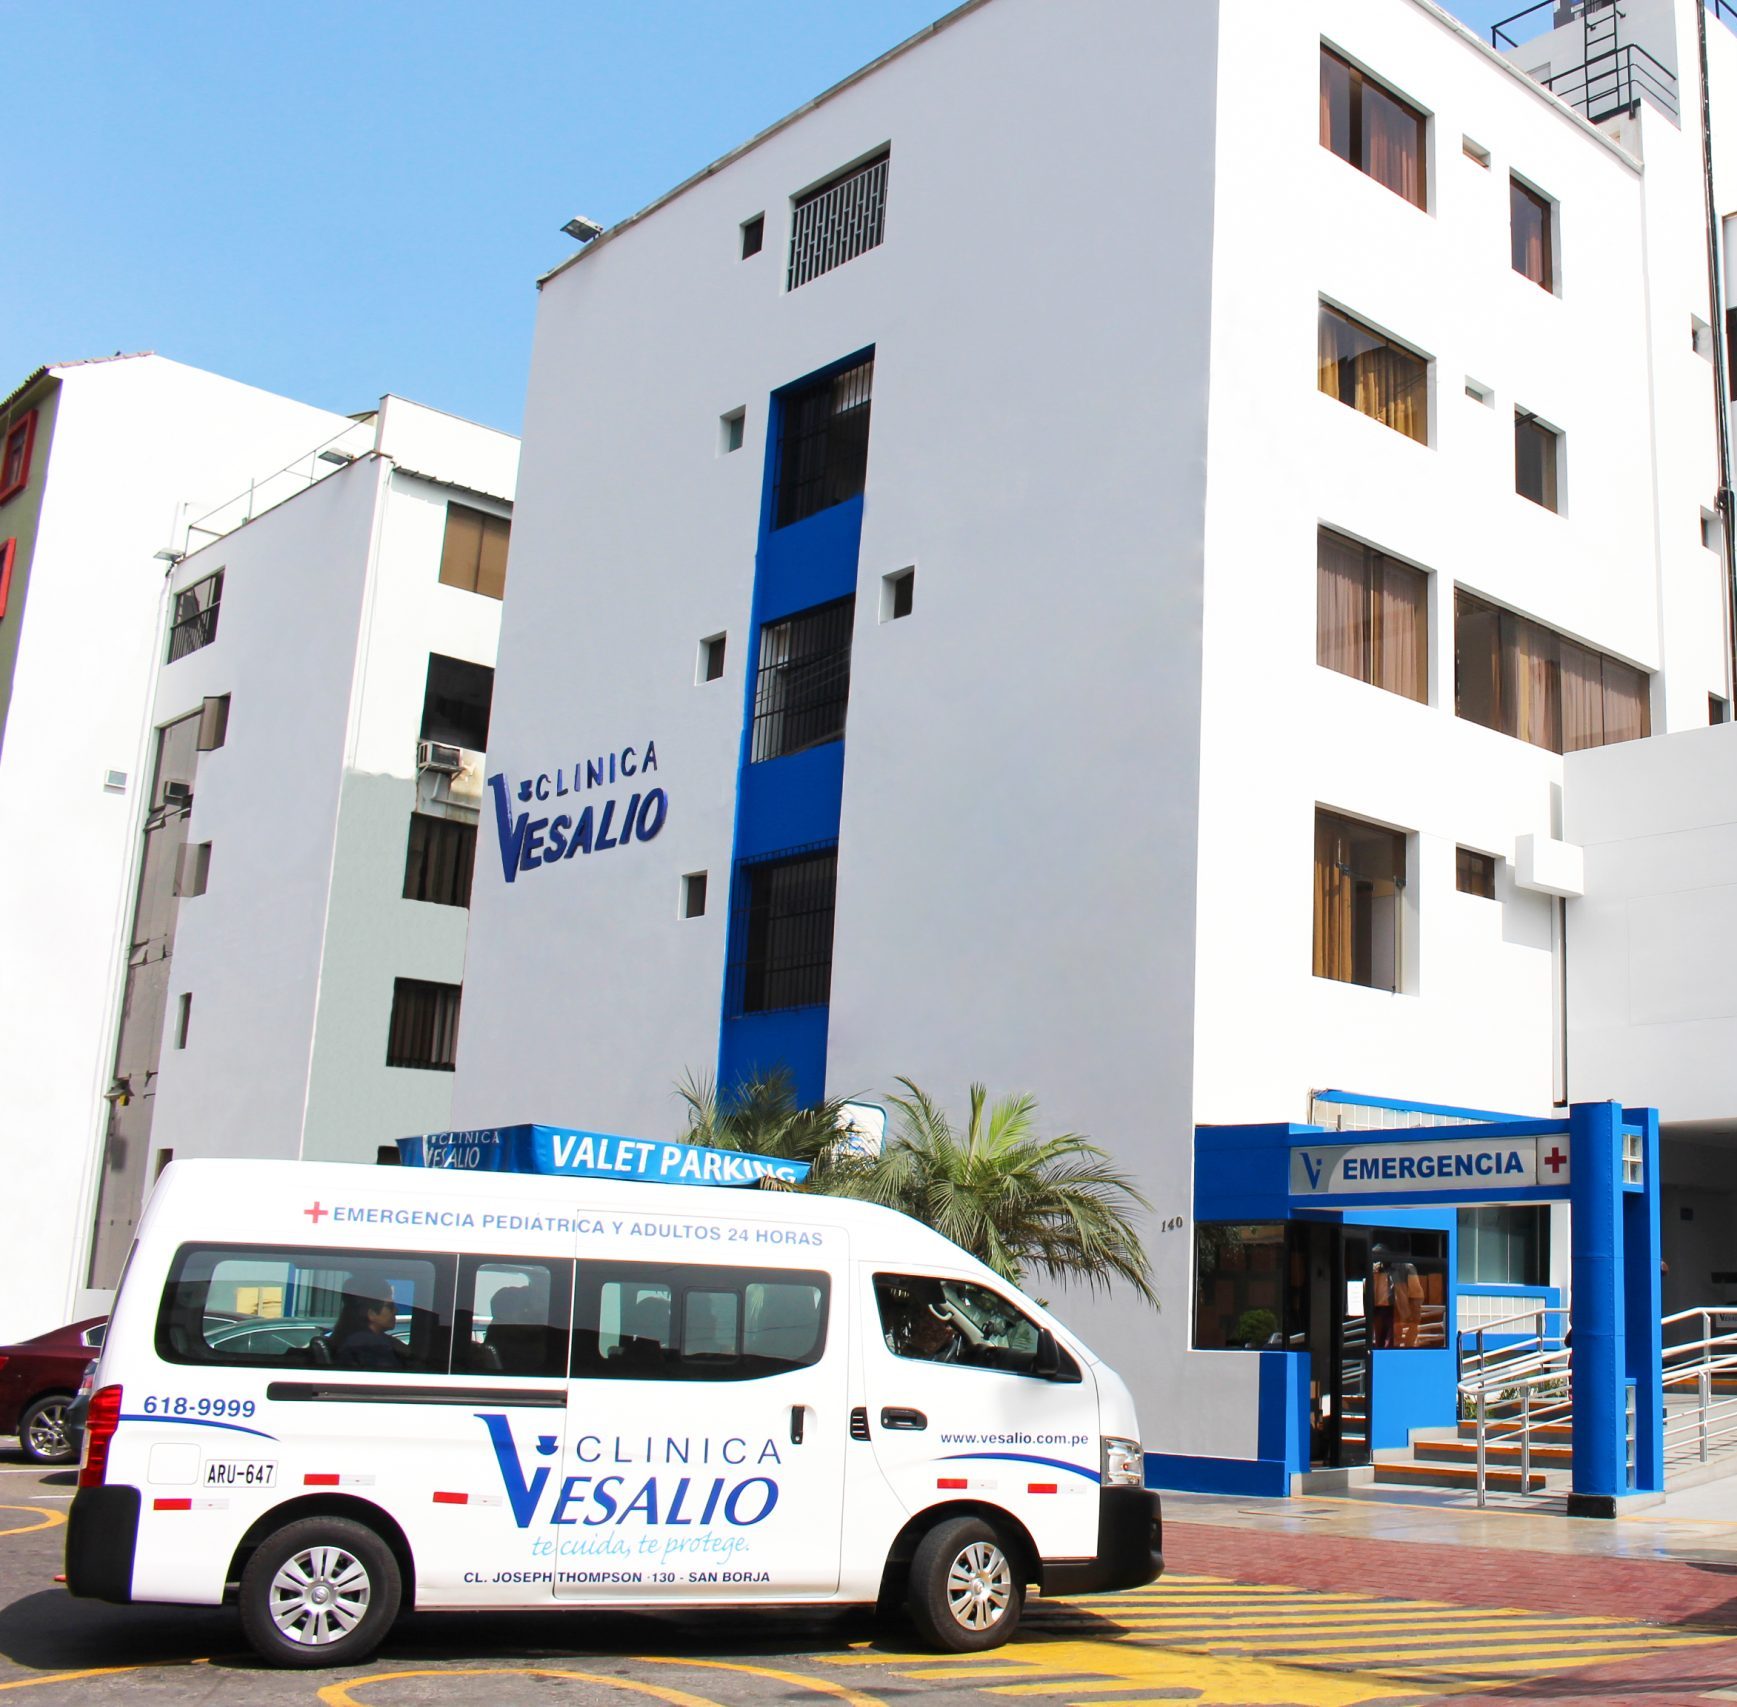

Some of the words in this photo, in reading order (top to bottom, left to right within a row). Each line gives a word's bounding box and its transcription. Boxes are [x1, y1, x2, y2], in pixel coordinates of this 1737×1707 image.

[535, 740, 658, 802] CLINICA
[487, 772, 669, 883] VESALIO
[422, 1134, 480, 1169] VESALIO
[439, 1131, 500, 1145] CLINICA
[552, 1134, 656, 1173] VALET
[1342, 1151, 1524, 1181] EMERGENCIA
[333, 1206, 474, 1228] EMERGENCIA
[612, 1221, 624, 1235] Y
[630, 1222, 721, 1241] ADULTOS
[727, 1228, 749, 1242] 24
[755, 1229, 823, 1247] HORAS
[143, 1395, 256, 1418] 618-9999
[576, 1436, 782, 1465] CLINICA
[940, 1432, 1089, 1447] www.vesalio.com.pe
[207, 1463, 274, 1484] ARU-647
[473, 1413, 780, 1529] VESALIO
[532, 1535, 555, 1556] te
[559, 1530, 632, 1558] cuida,
[638, 1534, 659, 1554] te
[660, 1531, 751, 1565] protege.
[463, 1572, 488, 1584] CL.
[492, 1572, 553, 1584] JOSEPH
[557, 1572, 643, 1583] THOMPSON
[688, 1571, 717, 1583] SAN
[722, 1571, 771, 1583] BORJA
